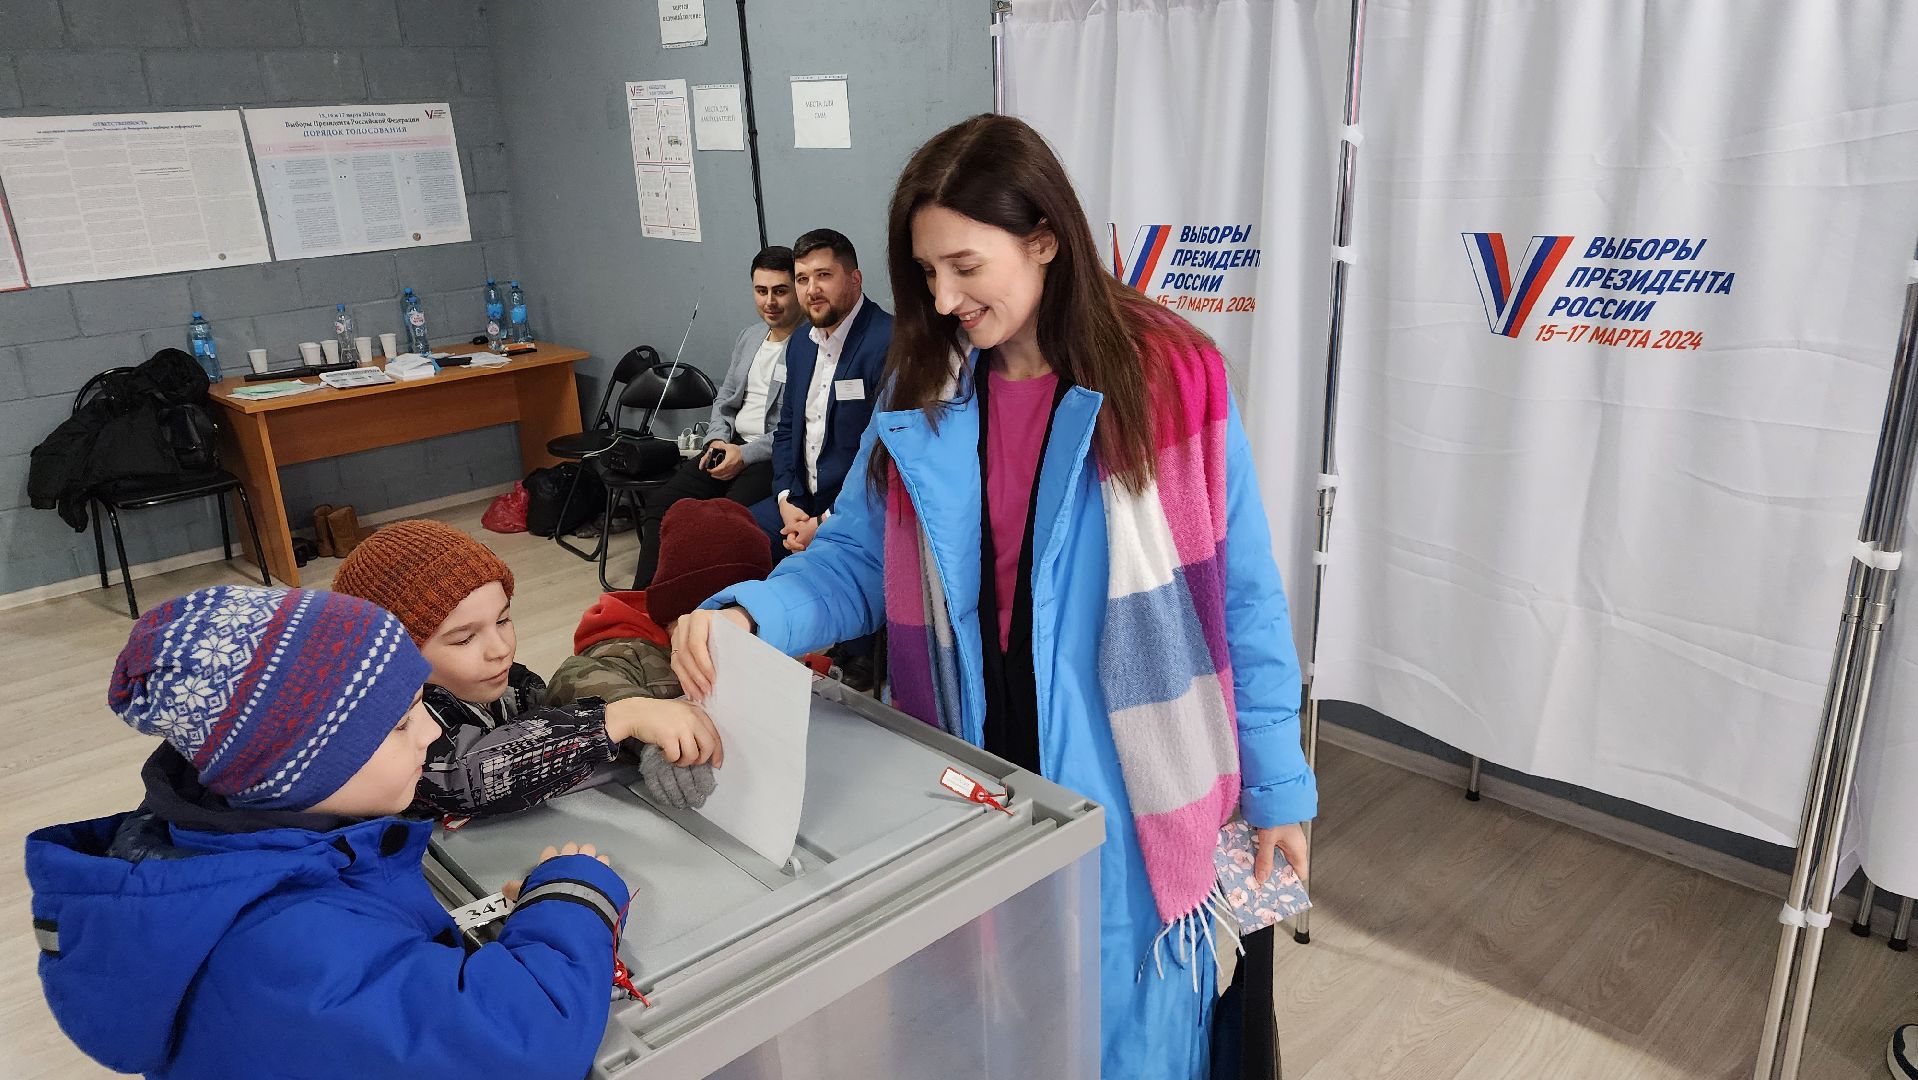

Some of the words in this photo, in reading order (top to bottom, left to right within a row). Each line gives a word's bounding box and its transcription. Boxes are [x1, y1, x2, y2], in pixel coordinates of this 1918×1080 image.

[303, 128, 344, 137] ПОРЯДОК
[346, 126, 407, 135] ГОЛОСОВАНИЯ
[1179, 223, 1252, 244] ВЫБОРЫ
[1170, 248, 1262, 270] ПРЕЗИДЕНТ
[1583, 236, 1708, 262] ВЫБОРЫ
[1160, 272, 1225, 292] РОССИИ
[1565, 266, 1737, 296] ПРЕЗИДЕНТА
[1188, 297, 1224, 313] МАРТА
[1226, 296, 1256, 313] 2024
[1547, 296, 1657, 322] РОССИИ
[1588, 327, 1652, 349] МАРТА
[1652, 330, 1704, 351] 2024
[465, 896, 517, 921] 347
